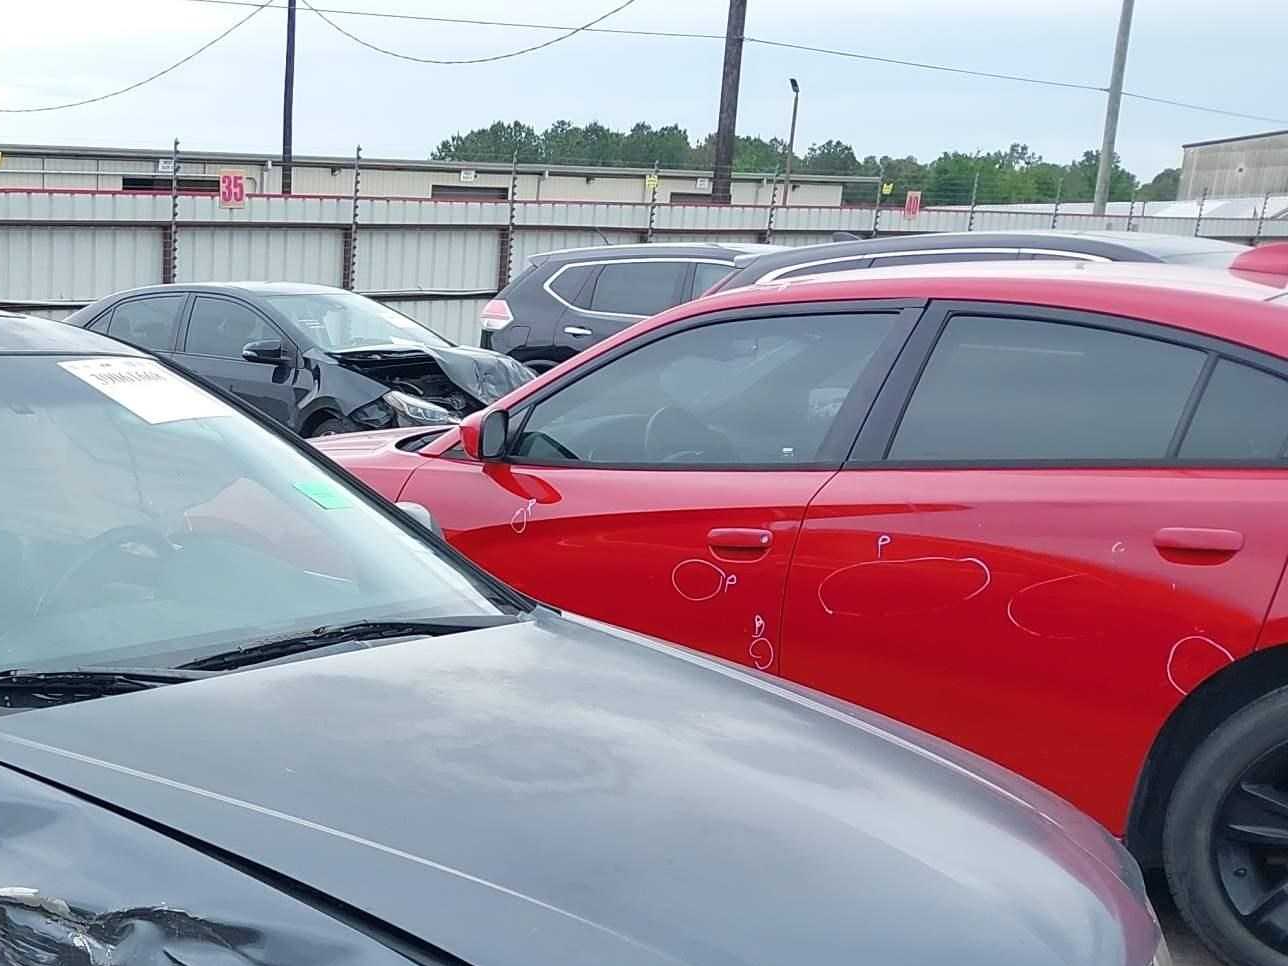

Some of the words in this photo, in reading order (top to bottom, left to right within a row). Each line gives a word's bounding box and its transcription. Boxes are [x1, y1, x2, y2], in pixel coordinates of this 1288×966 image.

[221, 175, 245, 202] 35
[877, 534, 892, 558] P
[724, 573, 738, 593] P
